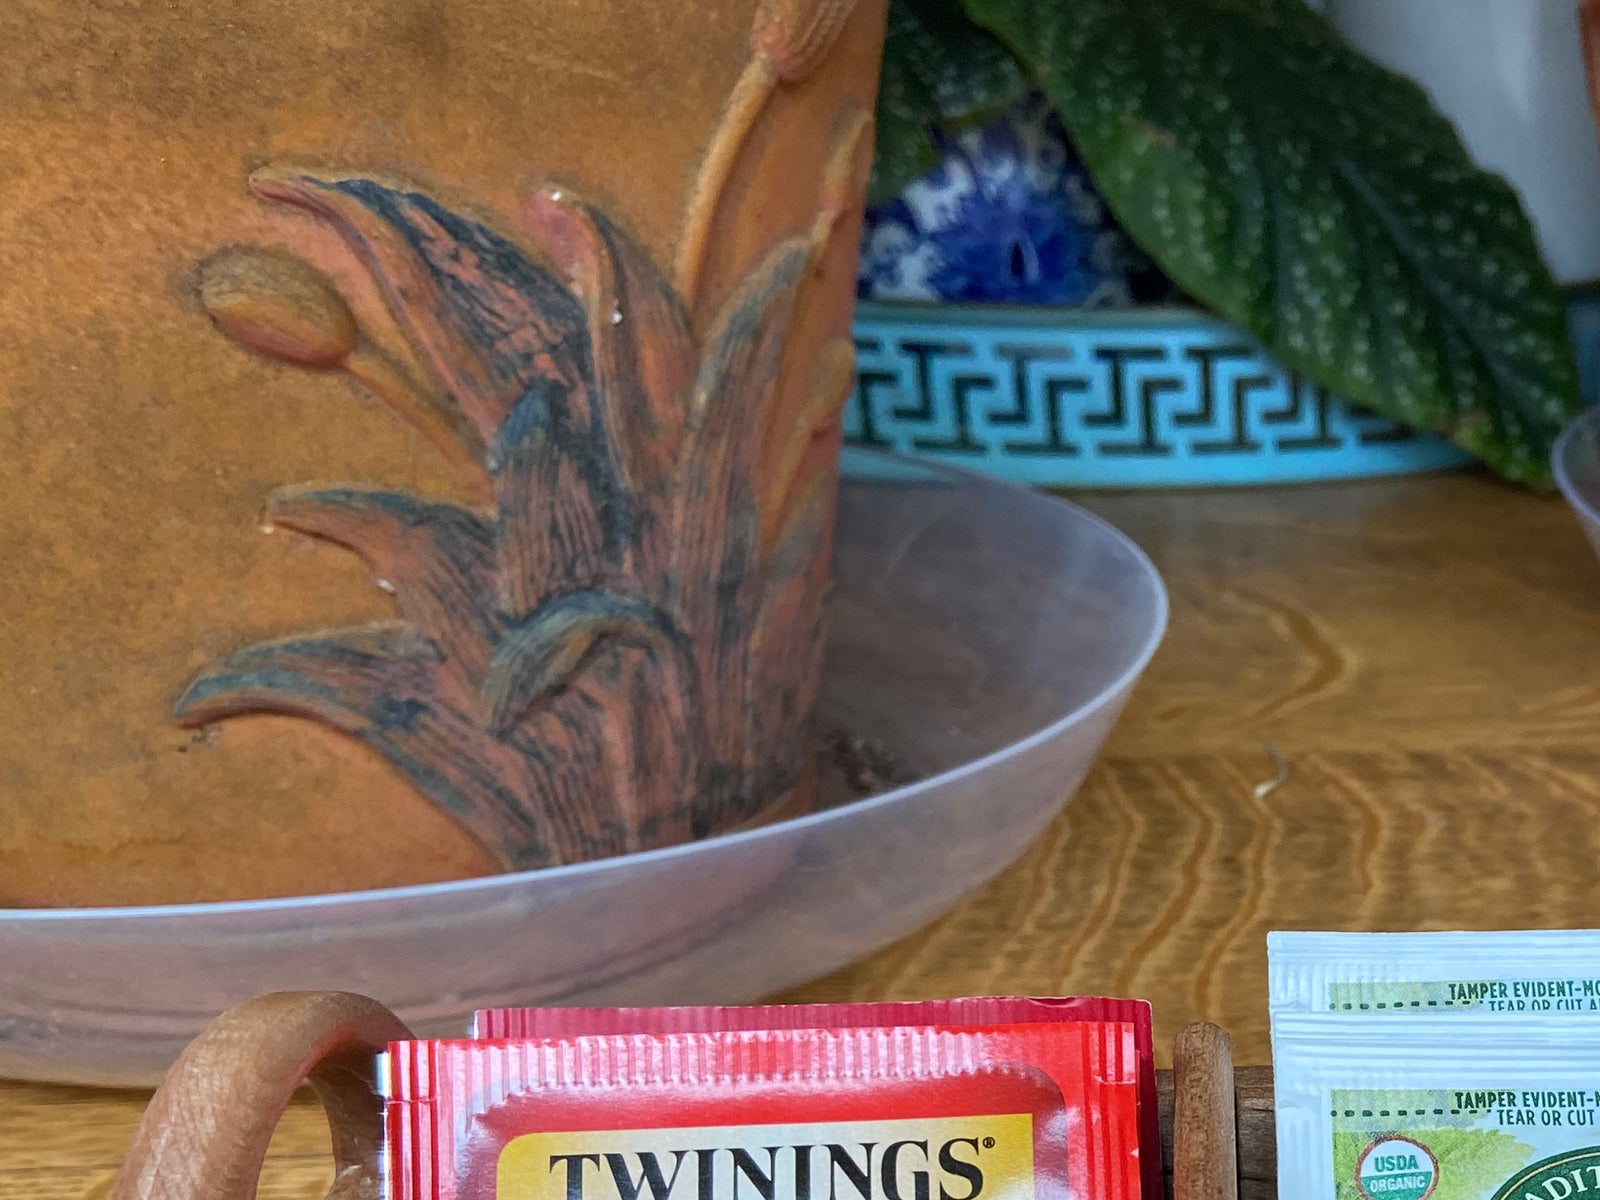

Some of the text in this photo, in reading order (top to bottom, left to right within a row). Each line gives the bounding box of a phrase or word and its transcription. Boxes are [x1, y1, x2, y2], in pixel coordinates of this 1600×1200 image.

[1449, 982, 1507, 1000] TAMPER
[1454, 1091, 1516, 1109] TAMPER
[1497, 1109, 1535, 1126] TEAR
[1541, 1109, 1562, 1126] OR
[1567, 1109, 1594, 1126] CUT
[1374, 1154, 1419, 1172] USDA
[1369, 1176, 1425, 1192] ORGANIC
